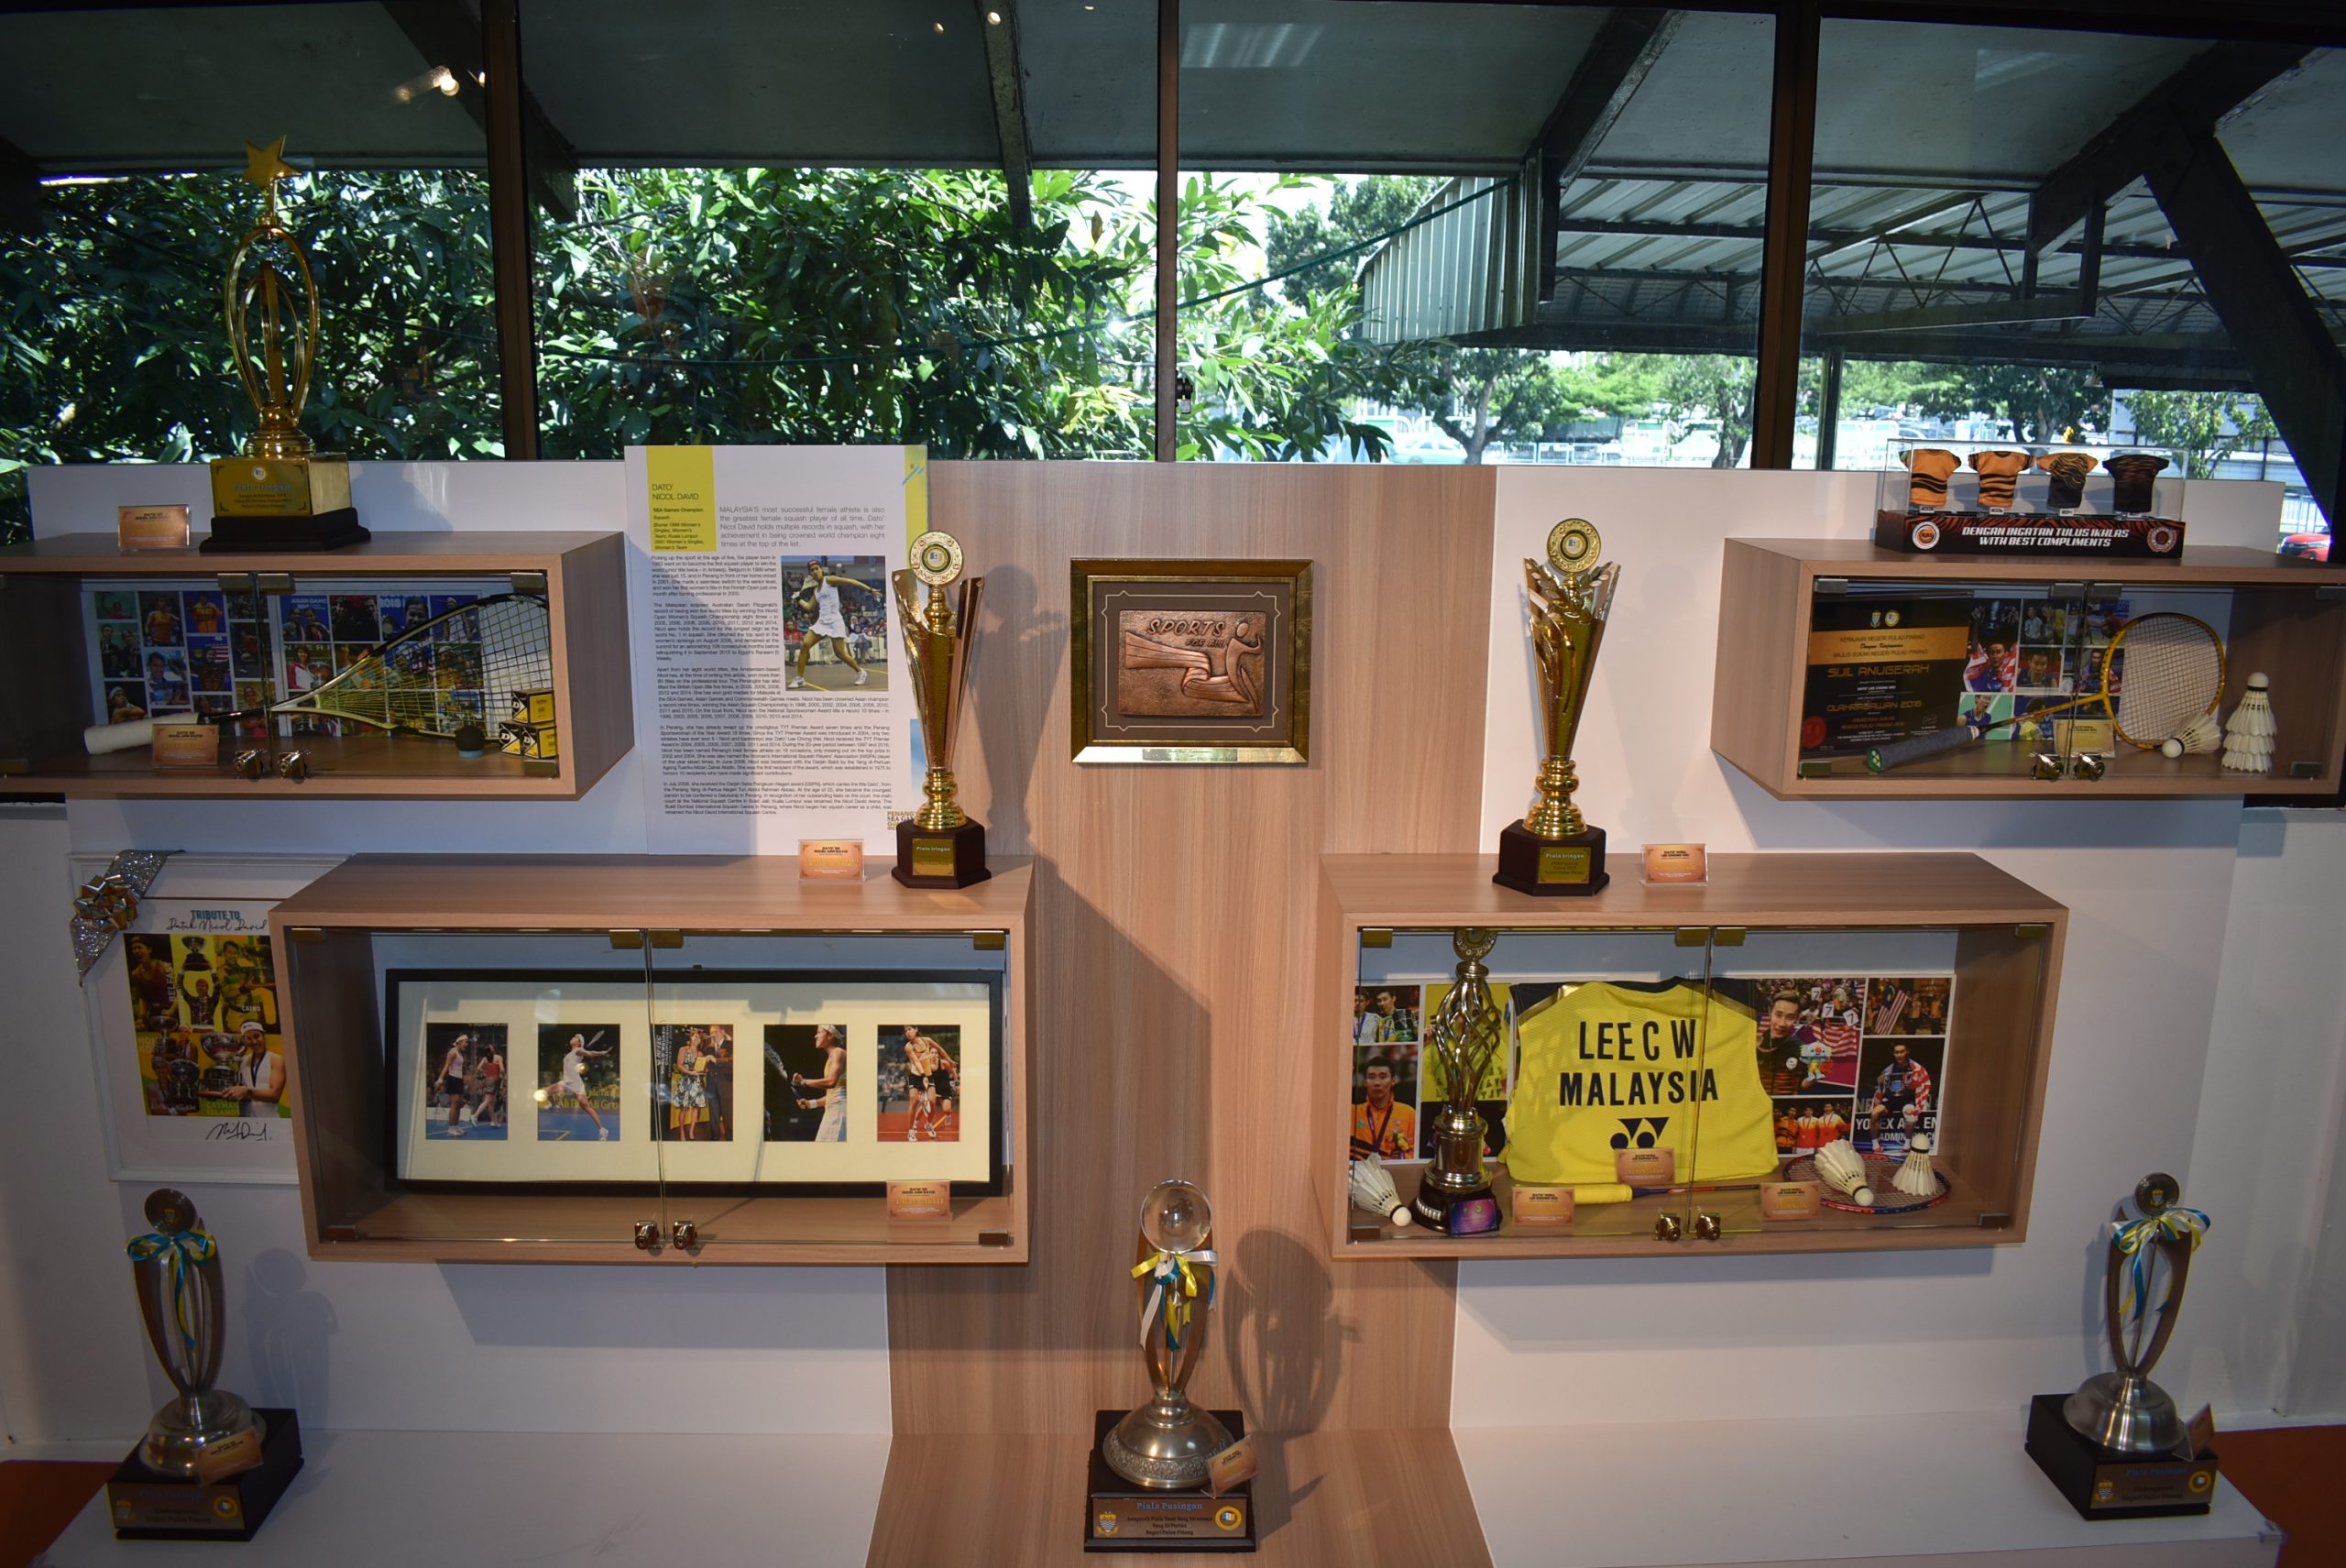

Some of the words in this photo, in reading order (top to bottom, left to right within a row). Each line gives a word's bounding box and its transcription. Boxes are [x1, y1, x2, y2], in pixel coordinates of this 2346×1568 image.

[732, 514, 758, 523] greatest
[784, 514, 807, 523] squash
[809, 514, 828, 523] player
[775, 523, 800, 532] multiple
[833, 523, 859, 532] squash,
[1962, 527, 2005, 537] DENGAN
[2006, 527, 2054, 537] INGATAN
[2055, 528, 2088, 538] TULUS
[2090, 528, 2130, 538] IKHLAS
[769, 532, 786, 540] being
[838, 532, 868, 540] champion
[870, 532, 885, 540] eight
[759, 540, 770, 549] top
[1979, 537, 2007, 546] WITH
[2008, 537, 2036, 546] BEST
[2037, 537, 2111, 547] COMPLIMENTS
[1146, 619, 1226, 637] SPORTS
[1858, 664, 1930, 675] ANUGERAH
[191, 910, 227, 920] TRIBUTE
[229, 910, 240, 920] TO
[1813, 991, 1820, 999] 7
[1825, 1006, 1832, 1015] 7
[1847, 1013, 1854, 1024] 7
[1579, 1021, 1635, 1061] LEE
[1642, 1021, 1659, 1061] C
[1671, 1019, 1695, 1058] W
[1559, 1068, 1718, 1107] MALAYSIA
[1856, 1117, 1894, 1130] YOEX
[1161, 1502, 1202, 1511] Pusingan
